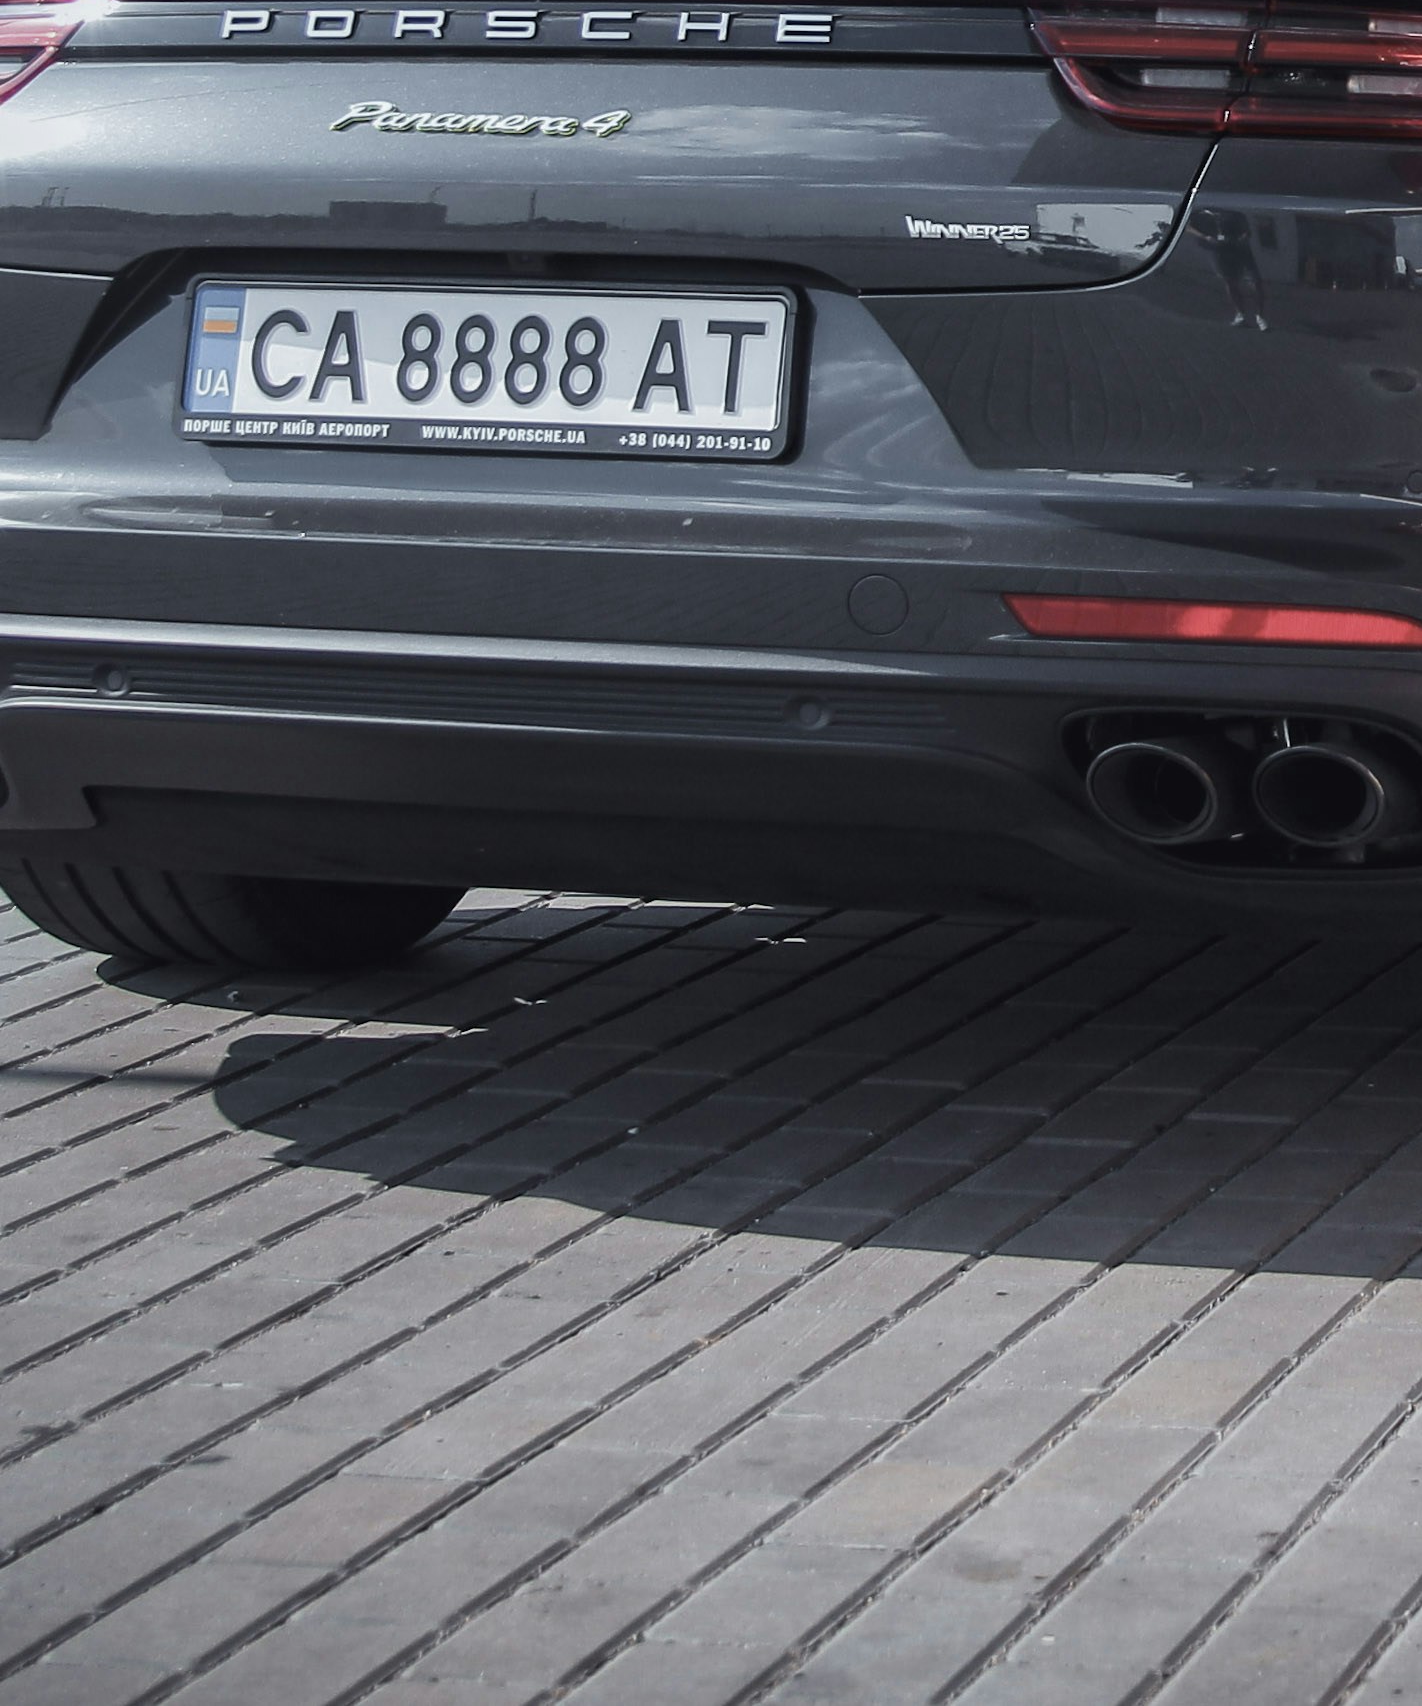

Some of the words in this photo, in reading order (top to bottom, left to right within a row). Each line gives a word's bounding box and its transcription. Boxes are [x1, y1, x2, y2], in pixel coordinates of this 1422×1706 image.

[221, 9, 833, 44] PORSCHE
[330, 101, 578, 135] Panamera
[582, 109, 632, 137] 4
[251, 309, 367, 401] CA
[396, 313, 606, 406] 8888
[631, 319, 767, 414] AT
[194, 369, 231, 397] UA
[183, 418, 231, 434] ПОРШЕ
[235, 420, 278, 436] ЦЕНТР
[282, 420, 315, 436] КИЇВ
[319, 423, 390, 438] АЕРОПОРТ
[422, 425, 586, 444] WWW.KYIV.PORSCHE.UA
[619, 432, 647, 446] +38
[652, 433, 691, 449] (044)
[696, 435, 771, 452] 201-91-10
